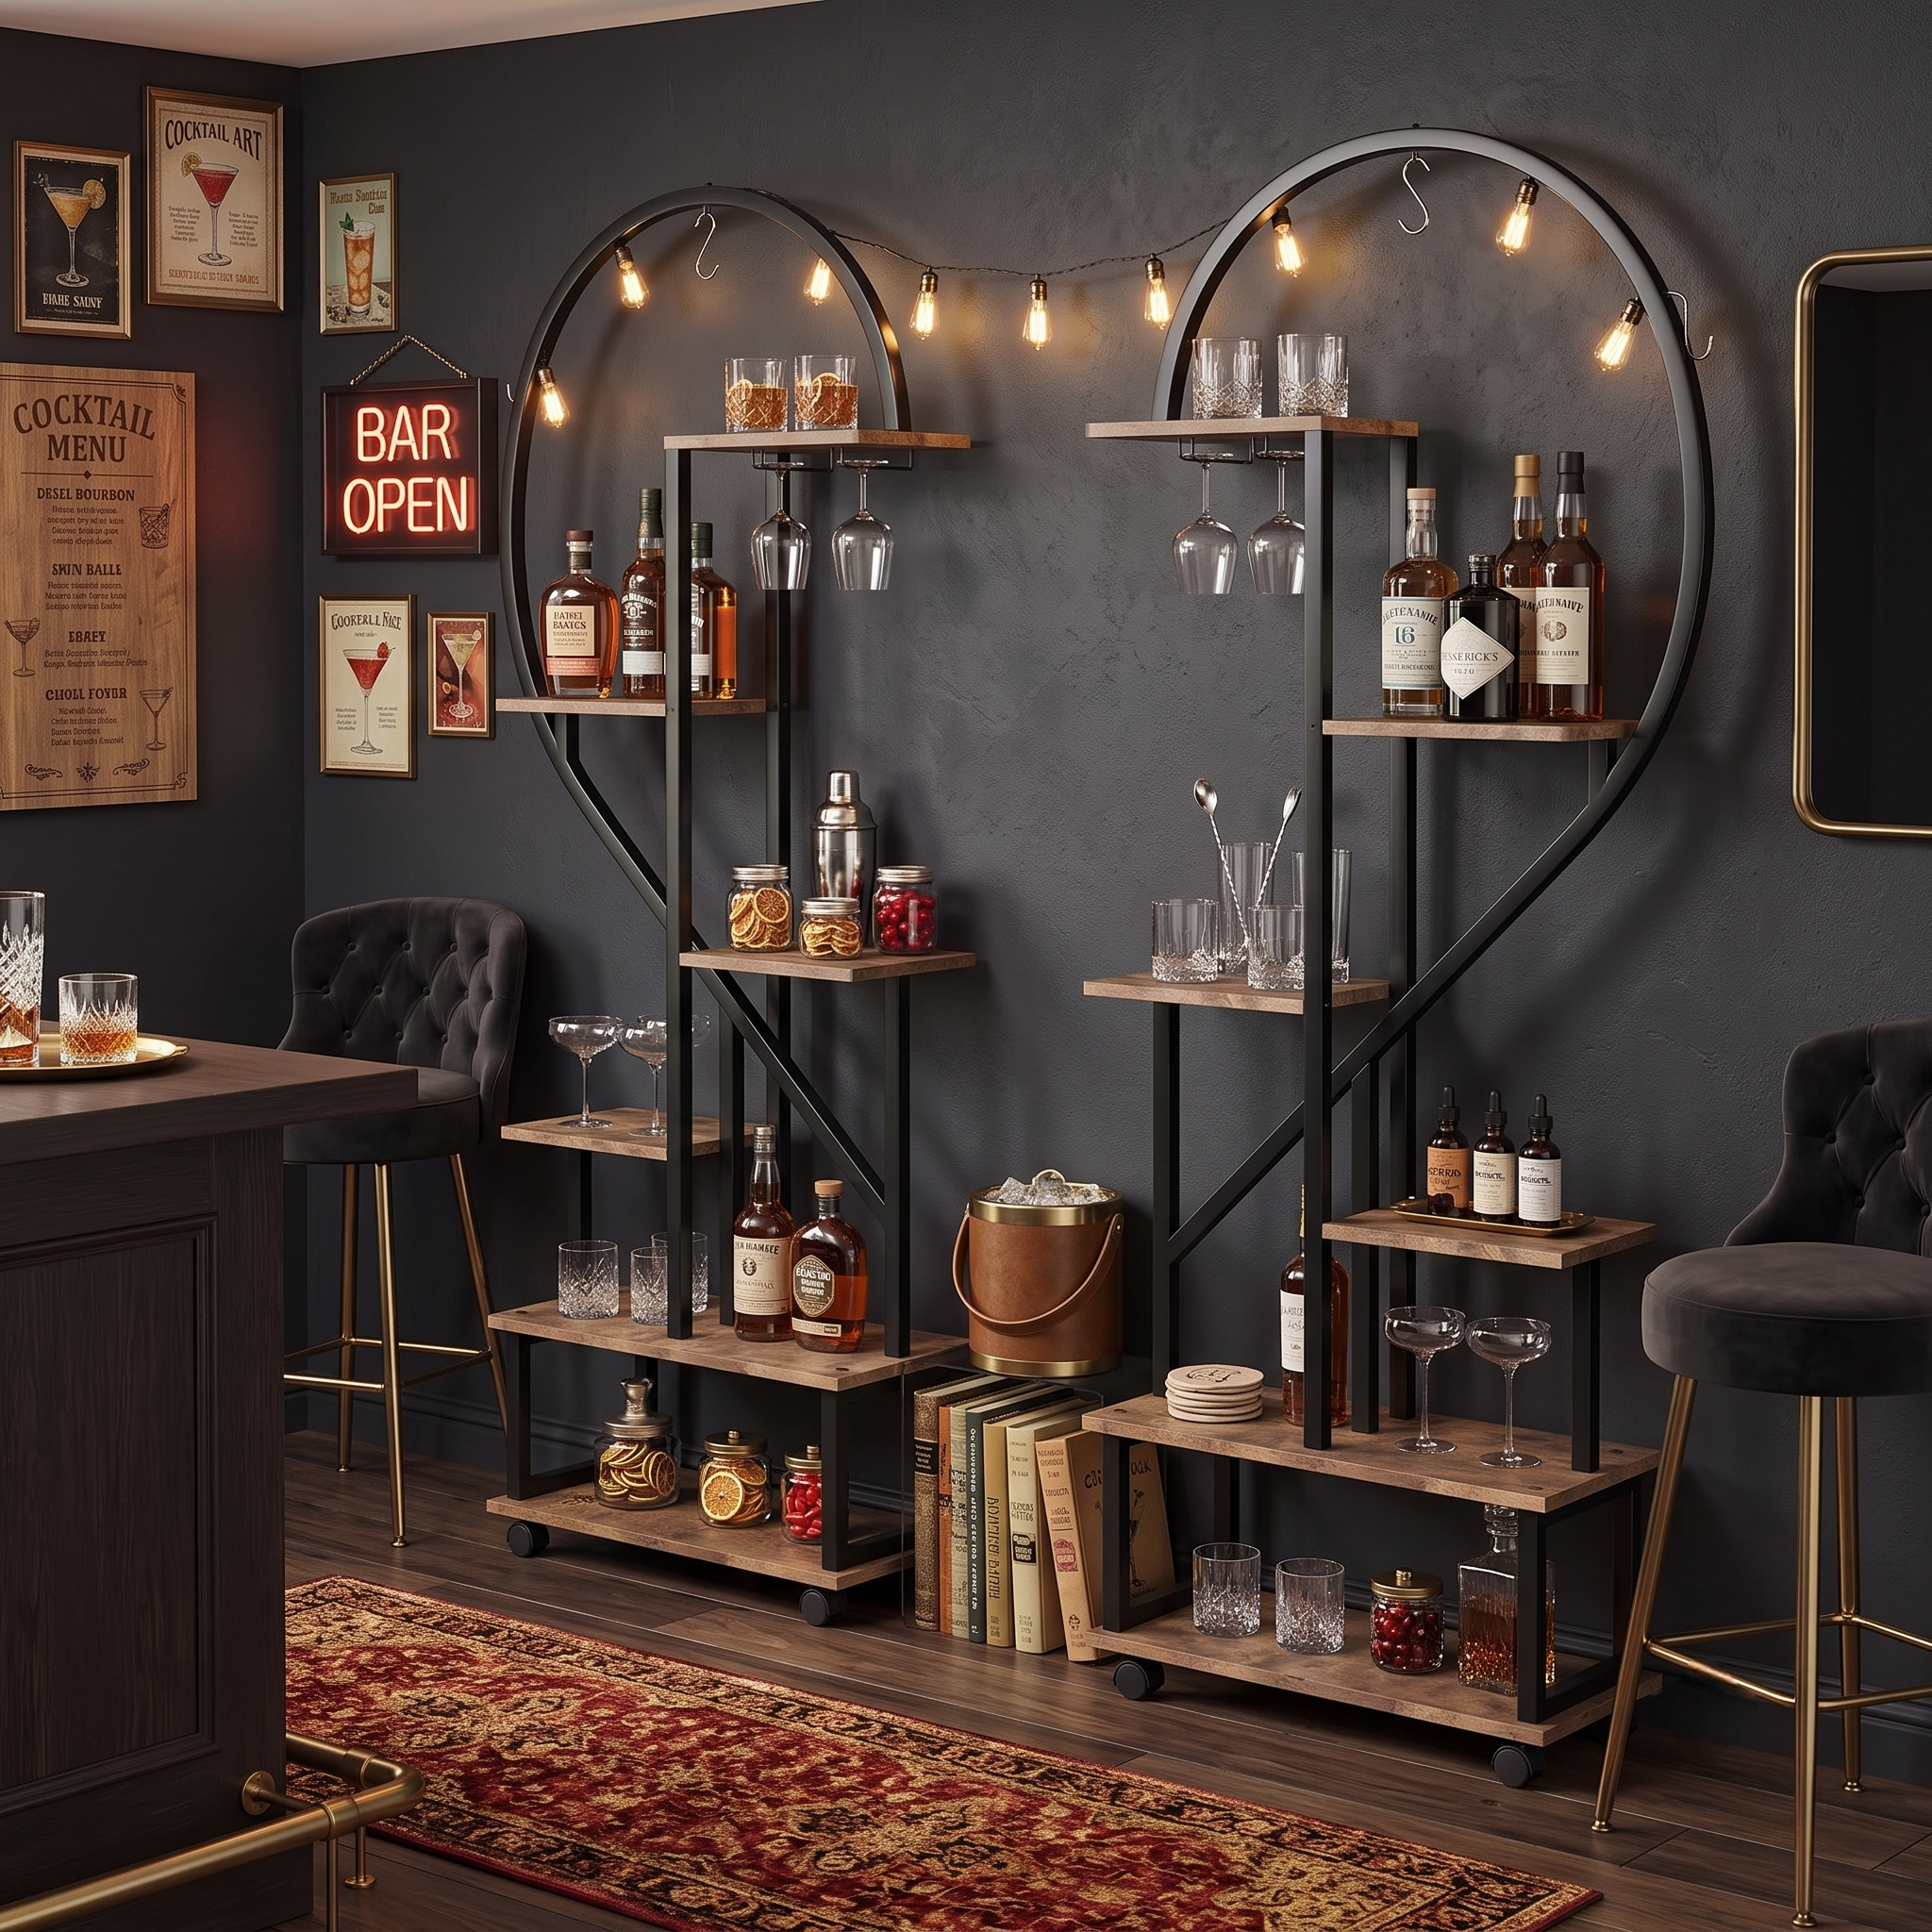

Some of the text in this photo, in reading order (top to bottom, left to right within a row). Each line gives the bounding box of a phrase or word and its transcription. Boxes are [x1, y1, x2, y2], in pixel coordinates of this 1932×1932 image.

[165, 120, 262, 161] COCKTAIL ART
[13, 393, 156, 441] COCKTAIL
[357, 404, 452, 462] BAR
[47, 434, 126, 463] MENU
[37, 487, 135, 501] DESEL BOURBON
[342, 475, 468, 534] OPEN
